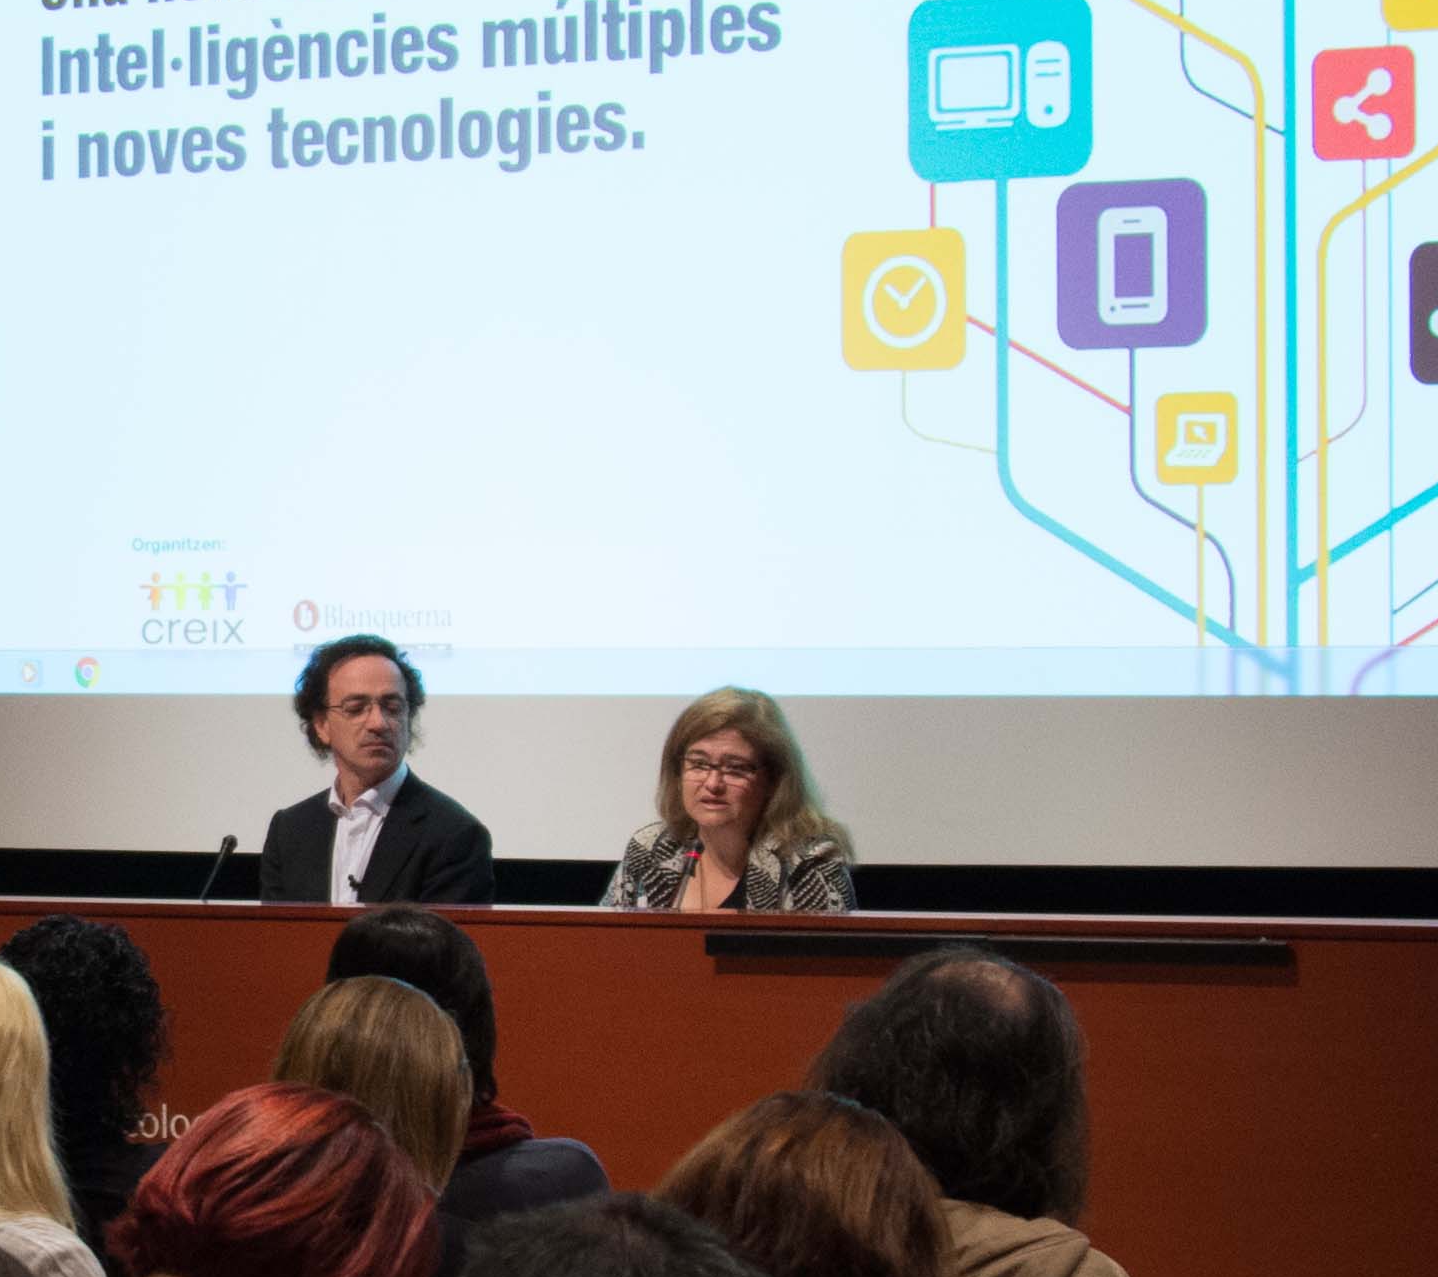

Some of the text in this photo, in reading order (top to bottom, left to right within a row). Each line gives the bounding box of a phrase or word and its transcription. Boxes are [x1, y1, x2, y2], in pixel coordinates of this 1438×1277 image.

[40, 13, 460, 100] Intel·ligències
[41, 90, 646, 181] i noves tecnologies.
[131, 536, 226, 555] Organitzen:
[141, 617, 245, 646] creix
[324, 604, 453, 634] Blanquerna
